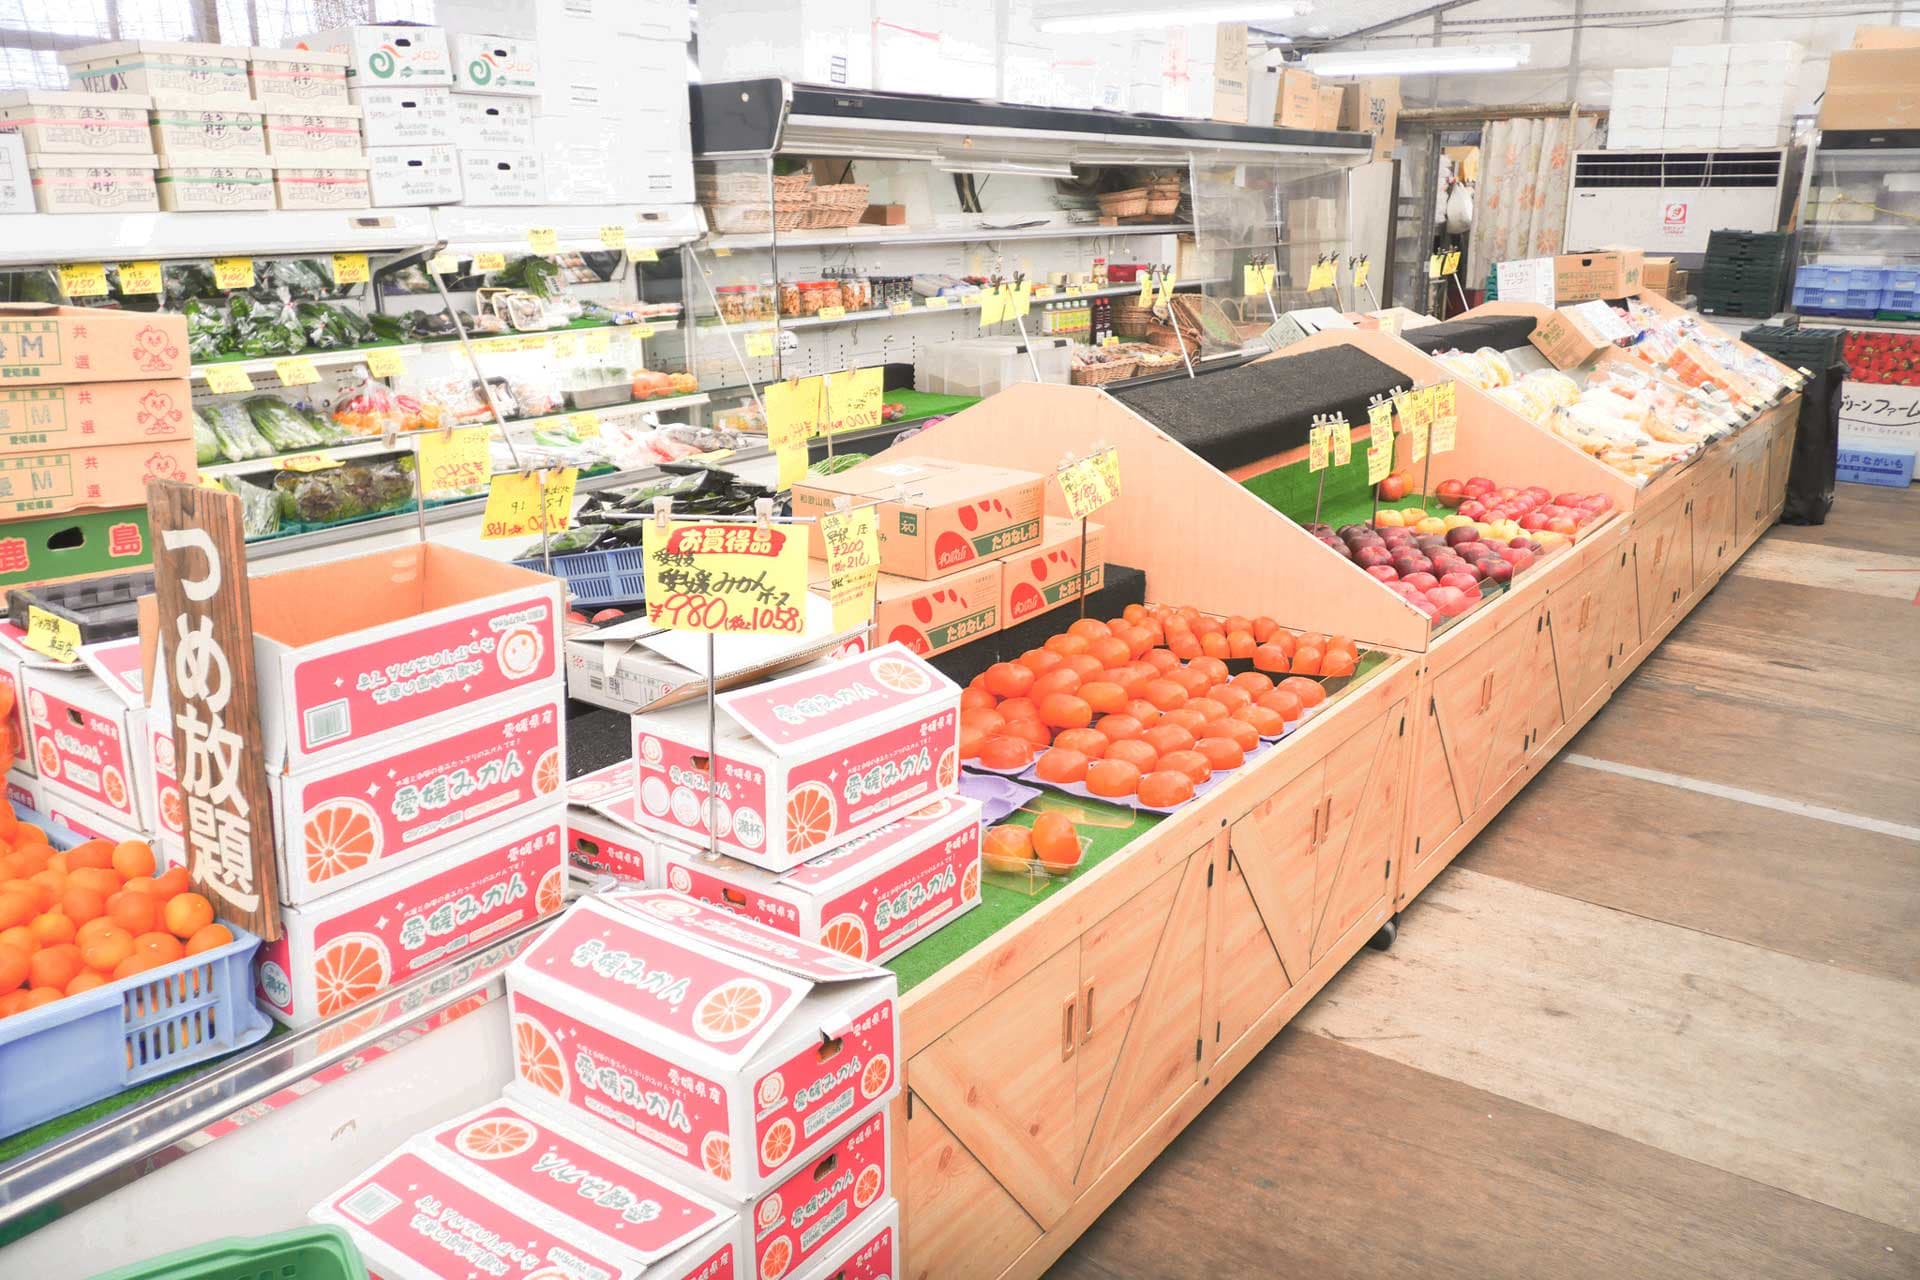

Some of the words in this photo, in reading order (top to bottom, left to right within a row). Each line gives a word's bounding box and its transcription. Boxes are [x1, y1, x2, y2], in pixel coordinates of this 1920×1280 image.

[21, 335, 44, 357] M
[31, 405, 51, 426] M
[32, 466, 53, 491] M
[109, 523, 143, 557] 島
[679, 527, 773, 553] お買得品
[991, 521, 1040, 552] たねなし柿
[649, 592, 728, 630] ¥980
[946, 611, 996, 643] たねなし柿
[161, 528, 259, 912] つめ放題
[772, 682, 878, 724] 愛媛みかん
[503, 710, 554, 738] 愛媛県産
[919, 713, 954, 737] 愛媛県産
[394, 751, 524, 820] 愛媛みかん
[725, 764, 762, 785] 愛媛県産
[844, 747, 932, 803] 愛媛みかん
[508, 831, 557, 862] 愛媛県産
[943, 828, 976, 854] 愛媛県産
[402, 873, 527, 949] 愛媛みかん
[757, 899, 796, 921] 愛媛県産
[874, 864, 956, 930] 愛媛みかん
[572, 941, 690, 1005] 愛媛みかん
[576, 1053, 692, 1134] 愛媛みかん
[668, 1068, 721, 1105] 愛媛県産
[793, 1056, 862, 1112] 愛媛みかん
[847, 1119, 882, 1151] 愛媛県産
[530, 1151, 663, 1224] 愛媛みかん
[791, 1169, 854, 1229] 愛媛みかん
[856, 1233, 889, 1268] 愛媛県産
